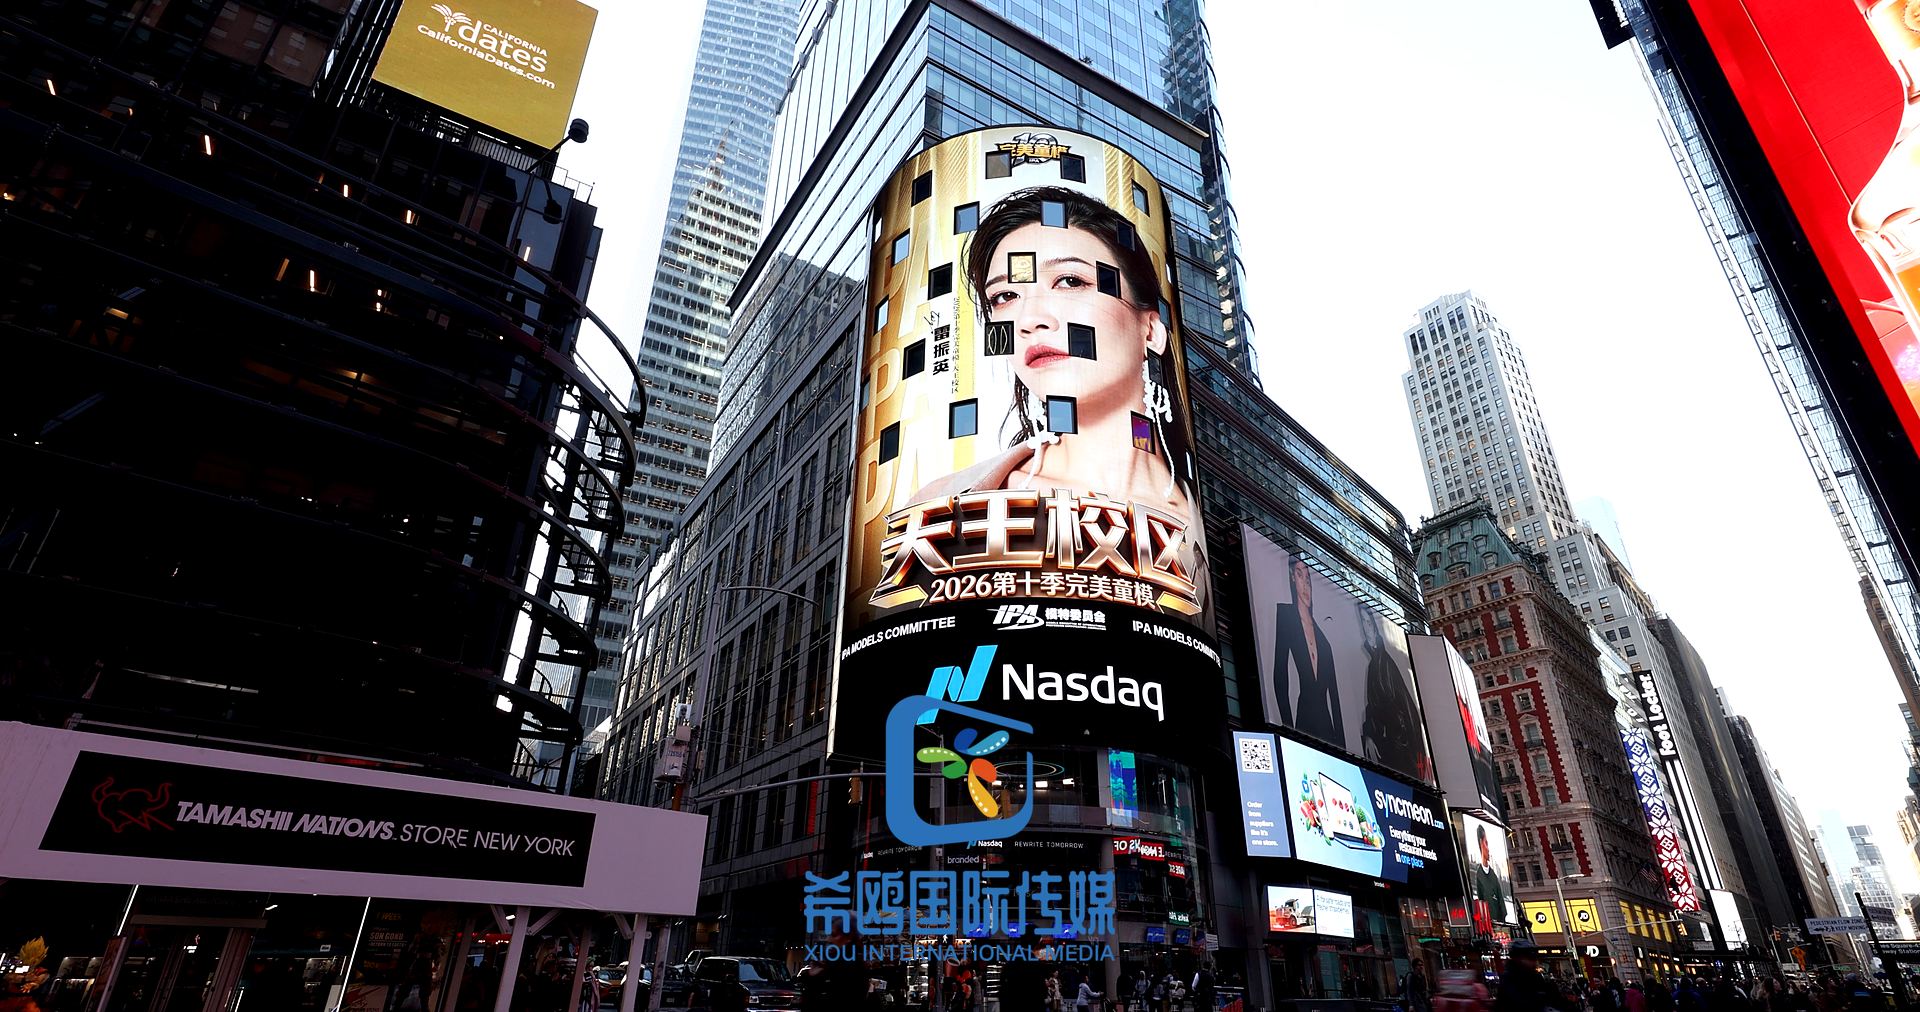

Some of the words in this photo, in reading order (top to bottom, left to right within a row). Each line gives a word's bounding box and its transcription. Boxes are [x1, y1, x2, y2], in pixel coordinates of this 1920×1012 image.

[417, 24, 556, 89] CaliforniaDates.com
[458, 20, 548, 73] dates
[483, 23, 548, 57] CALIFORNIA
[932, 323, 951, 376] 雷振英
[870, 488, 1200, 602] 天王校区
[930, 571, 1157, 610] 2026第十季完美童模
[993, 604, 1040, 625] IPA
[851, 632, 884, 654] MODELS
[884, 616, 956, 640] COMMITTEE
[1132, 620, 1152, 635] IPA
[1153, 624, 1193, 647] MODELS
[1002, 663, 1165, 722] Nasdaq
[1375, 789, 1445, 830] syncmeon.com
[176, 801, 294, 832] TAMASHII
[292, 813, 395, 841] NATIONS
[400, 823, 469, 848] STORE
[474, 830, 520, 851] NEW
[523, 835, 576, 857] YORK
[977, 840, 1003, 848] Nasdaq
[1046, 841, 1084, 849] TOMORROW
[1389, 825, 1417, 847] Everything
[1416, 835, 1427, 847] your
[947, 855, 980, 864] branded
[1394, 849, 1402, 863] in
[1401, 854, 1411, 865] one
[1398, 842, 1424, 858] restaurant
[1579, 912, 1589, 920] JD
[1585, 944, 1600, 958] JD
